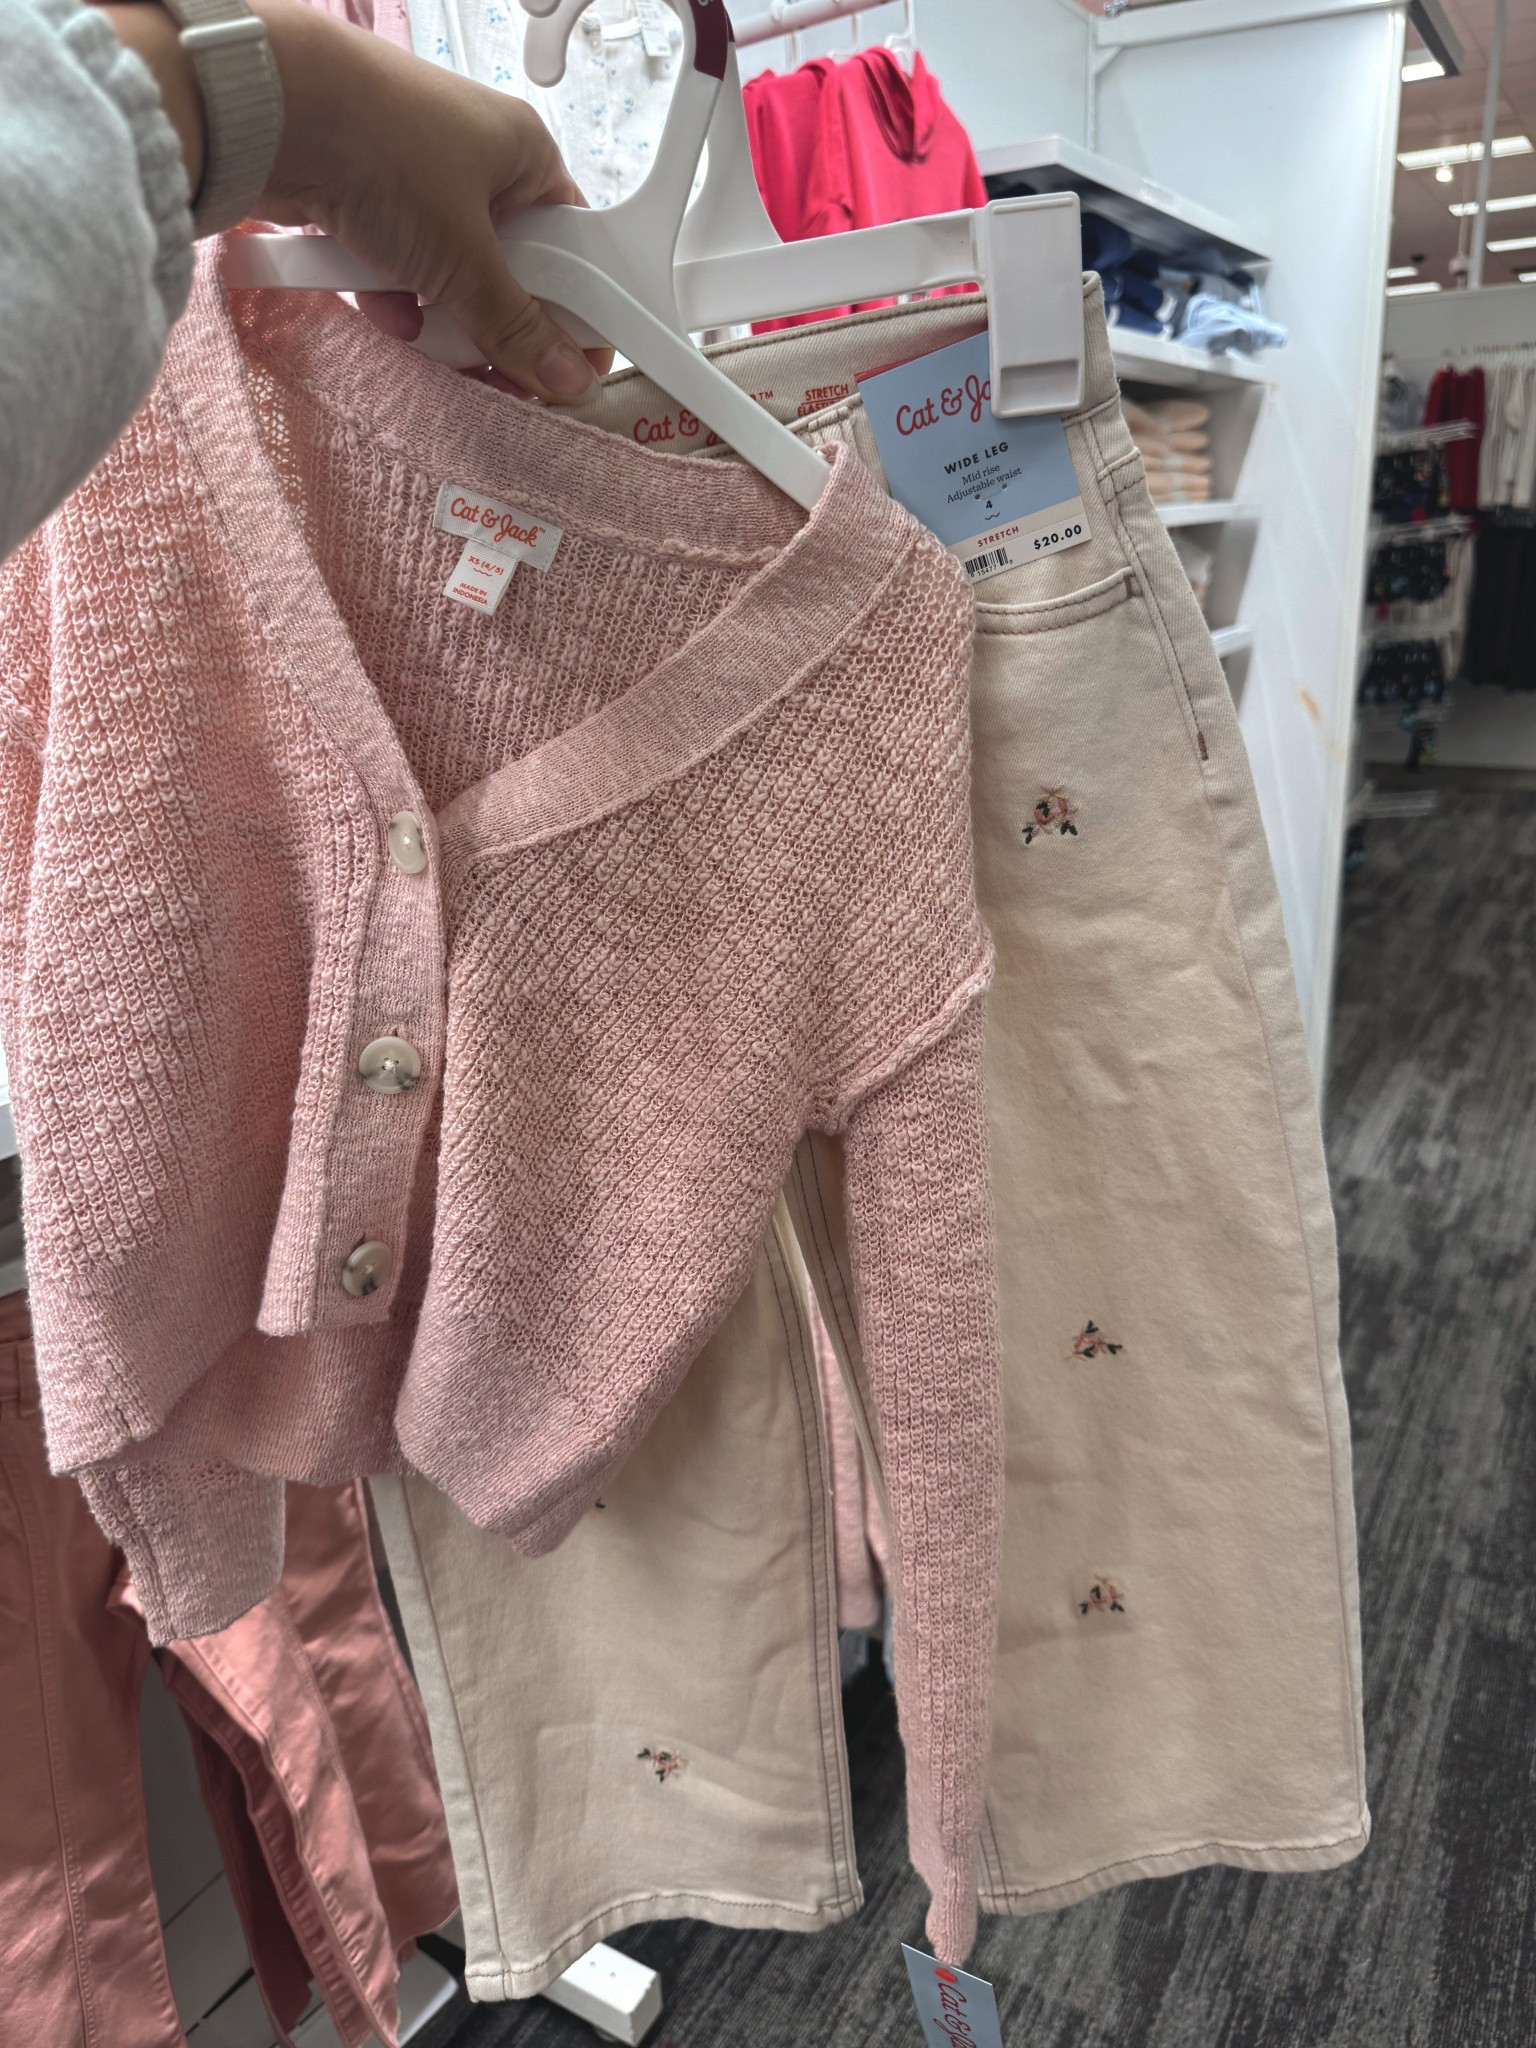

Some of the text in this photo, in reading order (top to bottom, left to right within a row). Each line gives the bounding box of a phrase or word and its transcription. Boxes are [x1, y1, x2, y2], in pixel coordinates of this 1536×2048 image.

[805, 383, 849, 401] STRETCH
[896, 398, 939, 436] Cat
[941, 387, 963, 416] &
[633, 415, 675, 445] Cat
[678, 408, 699, 437] &
[944, 441, 1008, 475] WIDE LEG
[947, 467, 1022, 504] Adjustable waist
[961, 465, 1000, 486] Mid rise
[450, 497, 478, 523] Cat
[480, 508, 500, 529] &
[985, 500, 993, 509] 4
[977, 526, 1019, 547] STRETCH
[1033, 524, 1082, 551] $20.00
[468, 555, 480, 565] XS
[452, 587, 488, 605] INDONESIA
[459, 582, 478, 593] MADE
